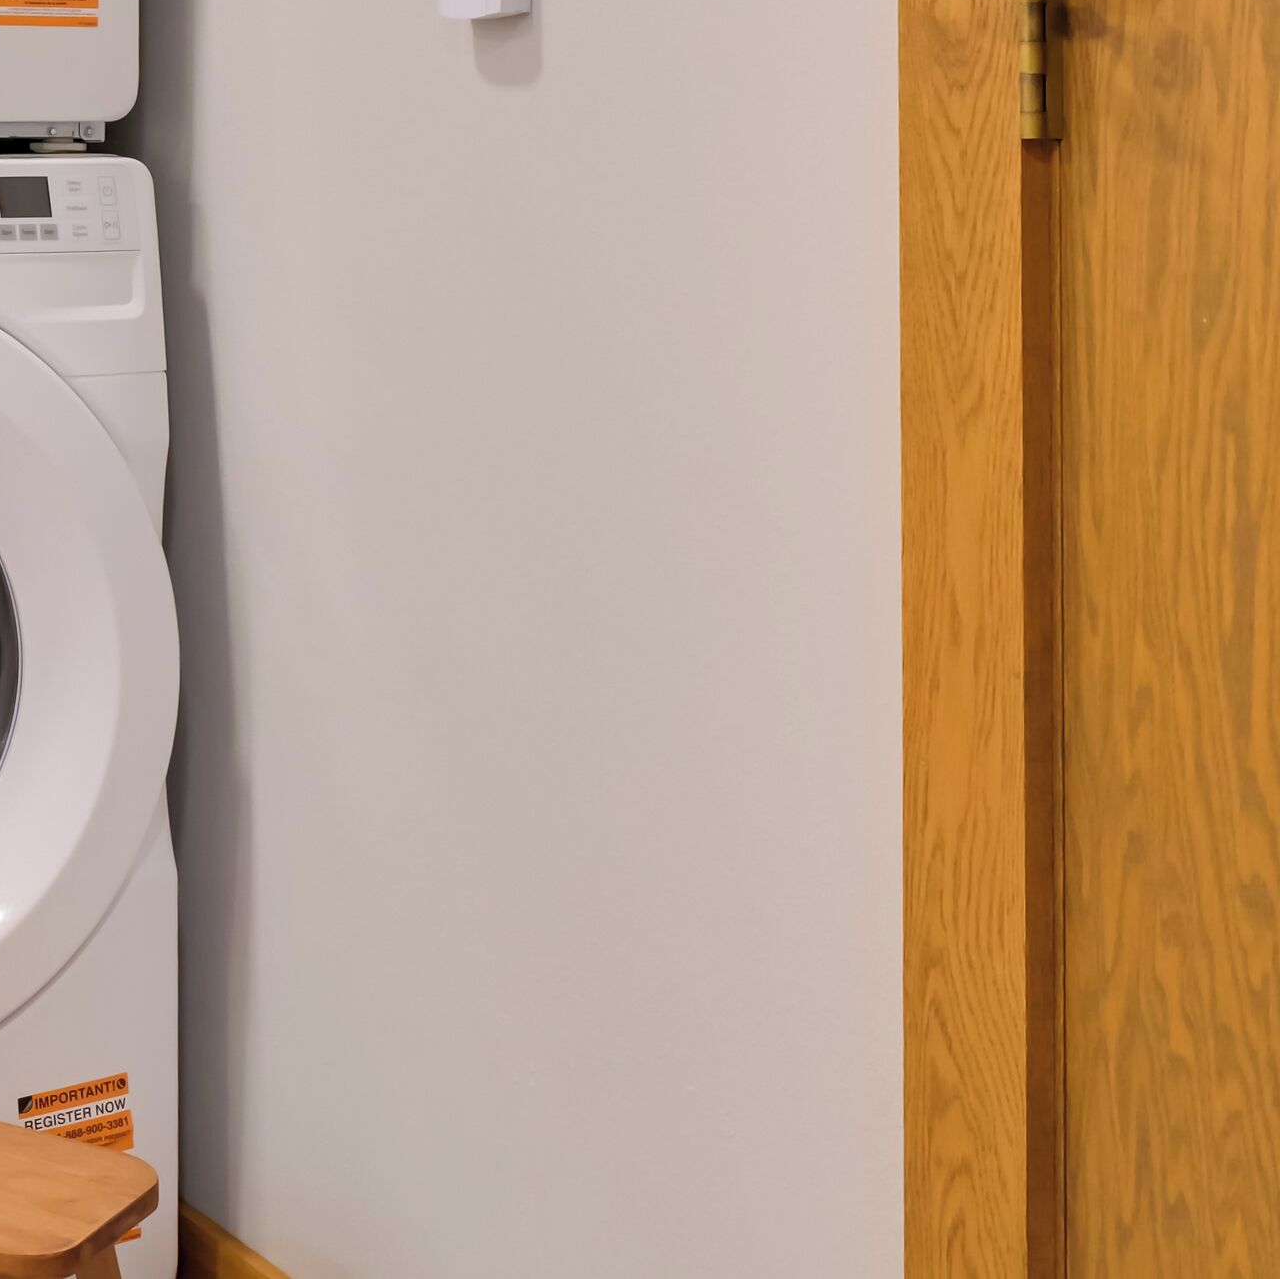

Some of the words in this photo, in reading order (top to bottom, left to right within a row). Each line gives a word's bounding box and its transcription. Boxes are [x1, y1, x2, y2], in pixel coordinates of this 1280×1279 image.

[34, 1080, 116, 1110] IMPORTANT!
[24, 1106, 92, 1131] REGISTER
[95, 1097, 127, 1116] NOW
